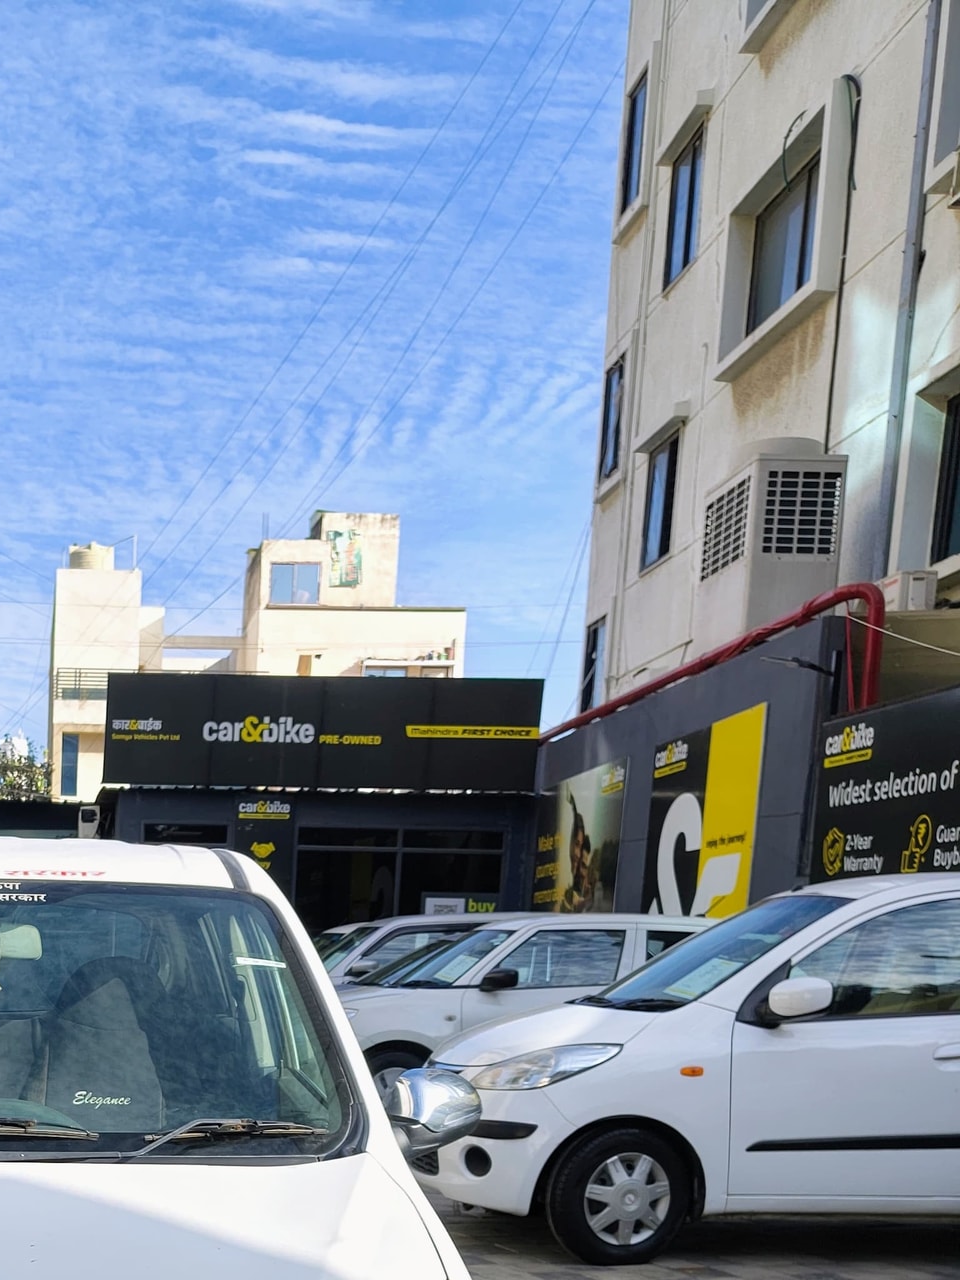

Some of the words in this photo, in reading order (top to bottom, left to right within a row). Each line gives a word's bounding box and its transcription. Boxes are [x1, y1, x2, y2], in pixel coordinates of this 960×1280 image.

[203, 716, 315, 744] car&bike
[319, 735, 382, 745] PRE-OWNED
[411, 728, 459, 736] Mahindra
[494, 729, 531, 737] CHOICE
[825, 722, 874, 755] car&bike
[655, 740, 688, 768] car&bike
[829, 778, 872, 808] Widest
[873, 768, 937, 801] selection
[940, 760, 960, 791] of
[239, 801, 290, 813] car&bike
[845, 834, 873, 851] 2-Year
[843, 854, 883, 874] Warranty
[933, 845, 960, 870] Buyb
[468, 898, 496, 913] buy
[72, 1090, 131, 1110] Elegance
